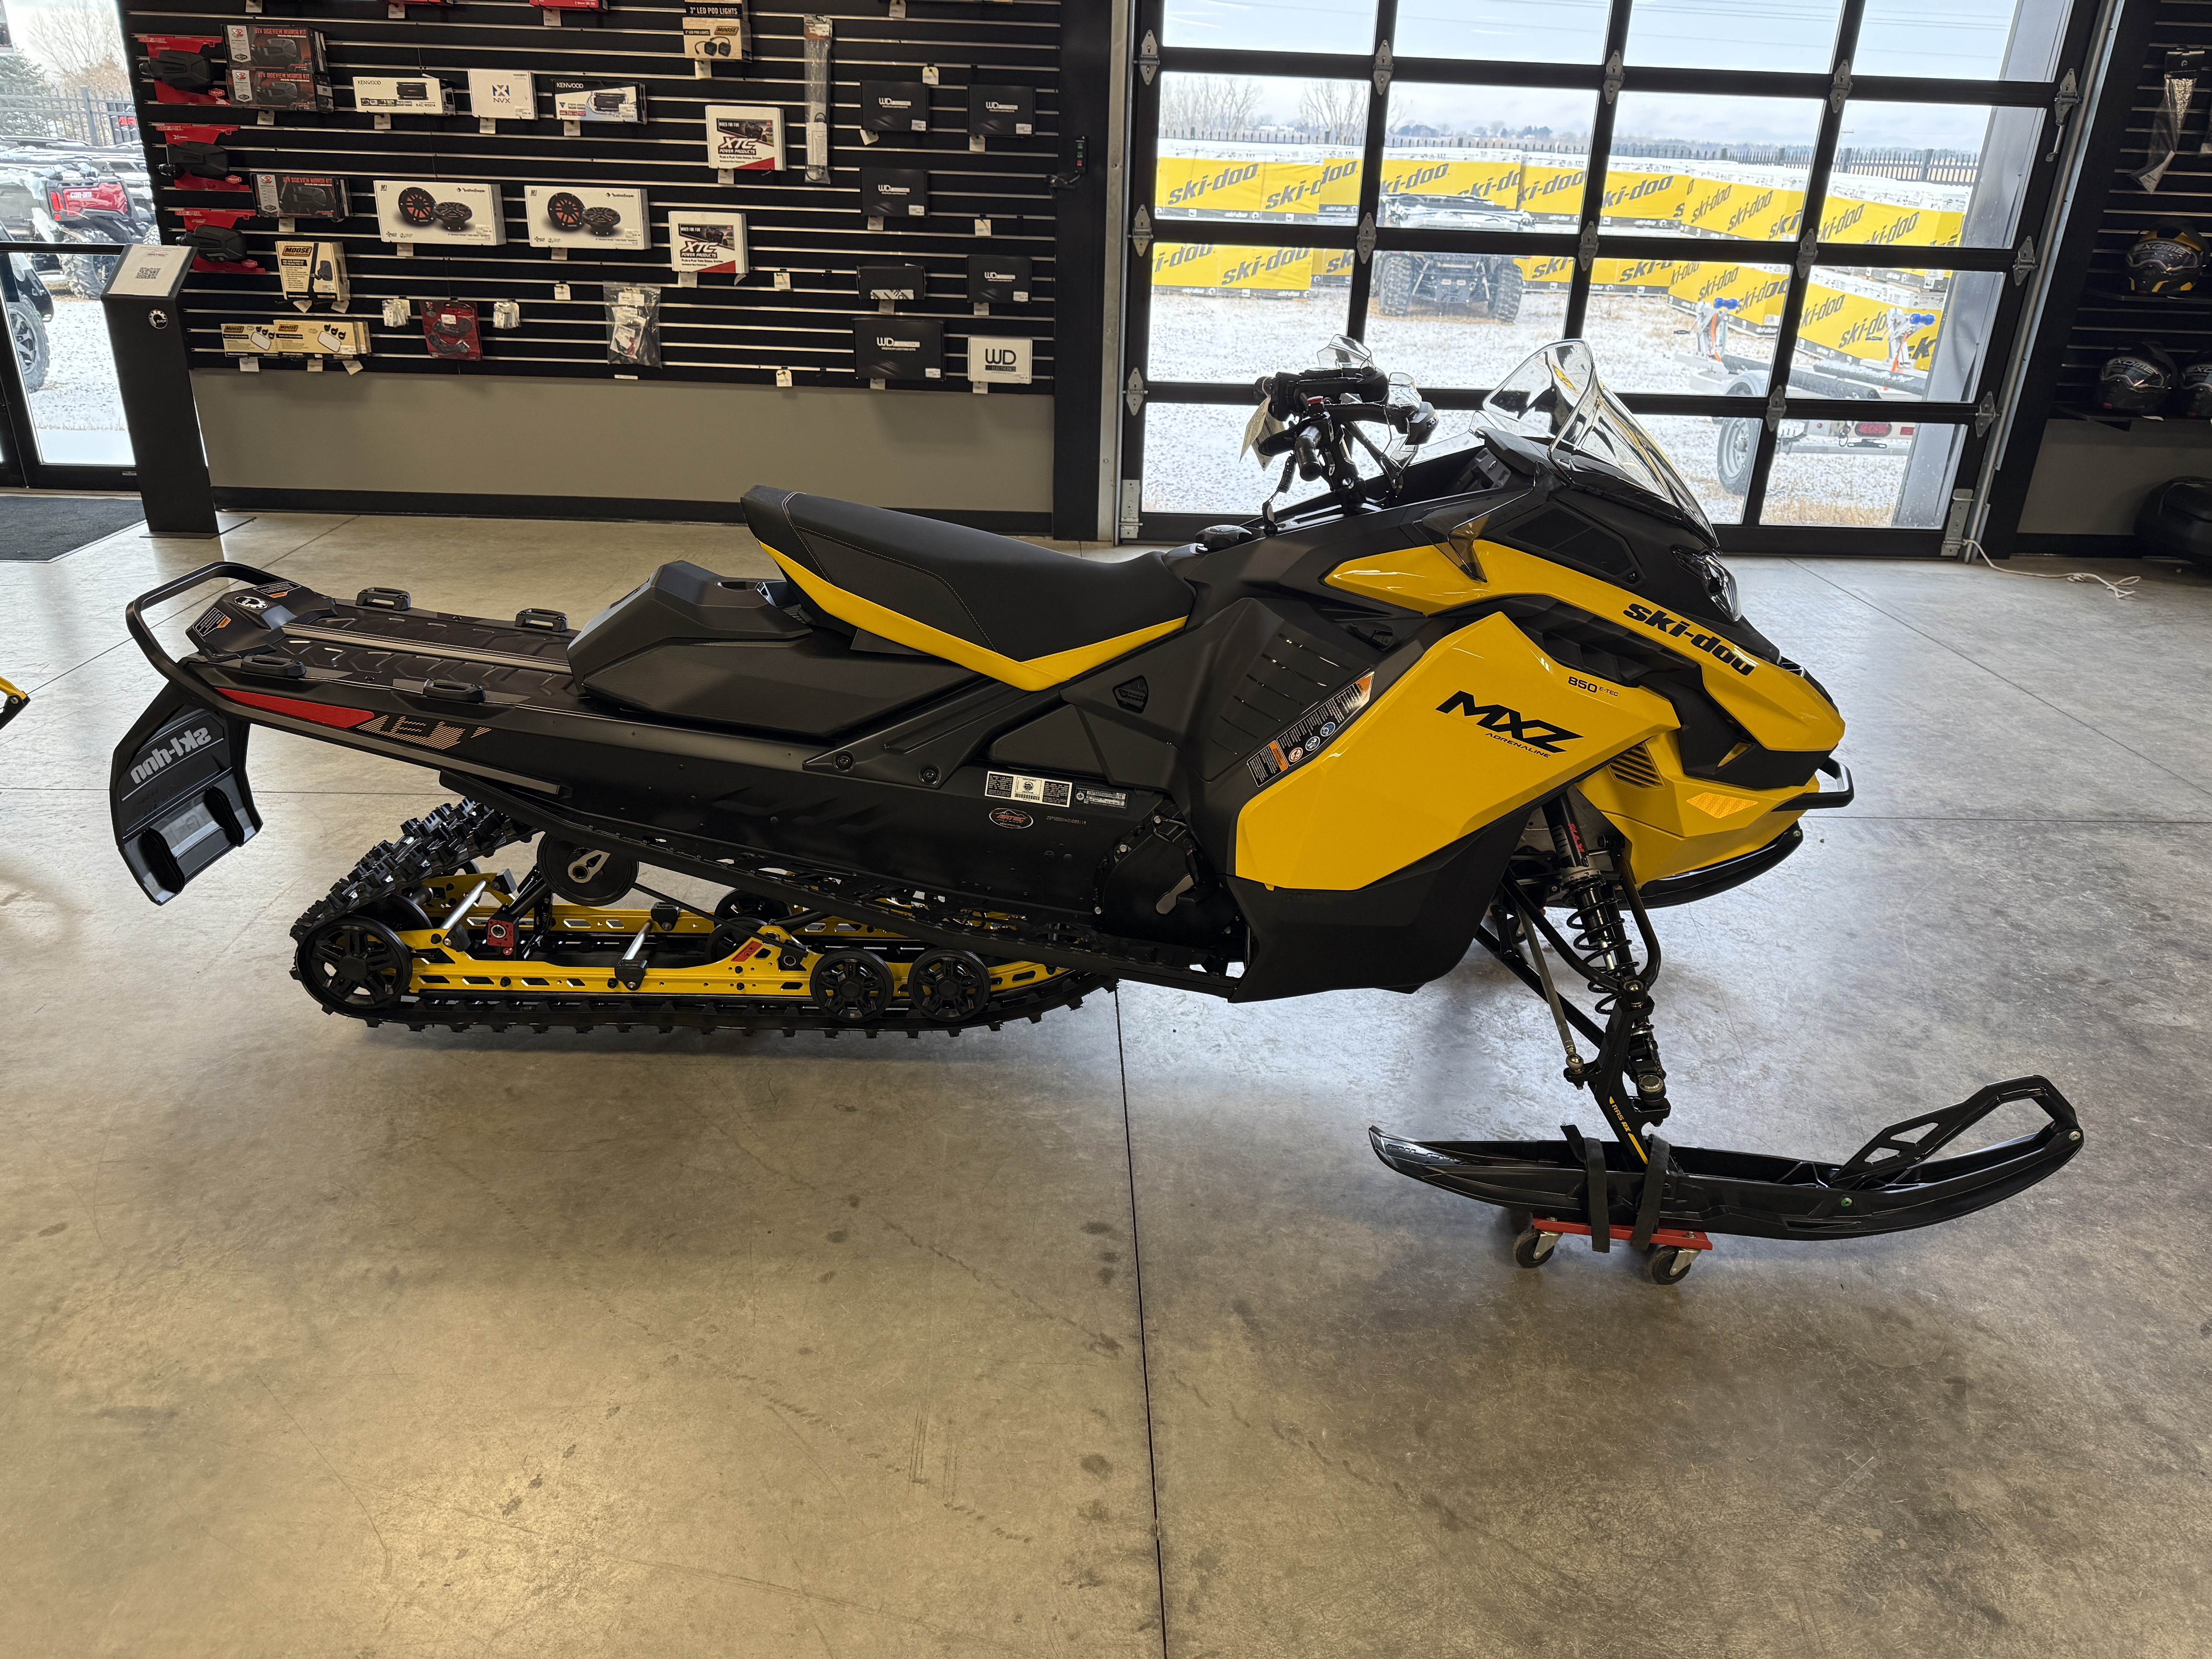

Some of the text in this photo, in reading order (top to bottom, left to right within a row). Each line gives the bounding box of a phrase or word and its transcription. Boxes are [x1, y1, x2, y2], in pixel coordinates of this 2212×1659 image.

[721, 137, 757, 149] XTC
[1168, 163, 1259, 205] ski-doo
[1603, 176, 1673, 208] ki-doo
[1691, 185, 1732, 223] ski-doo
[1728, 190, 1774, 232] ski-doo
[1819, 204, 1865, 241] ki-doo
[682, 242, 718, 252] XTC
[1698, 267, 1739, 301] ski-doo
[877, 337, 895, 347] WD
[1839, 311, 1887, 348] ski-do
[985, 349, 1017, 365] WD
[1623, 603, 1756, 676] ski-doo
[1568, 676, 1619, 697] 850 E-TEC
[1435, 690, 1585, 753] MXZ
[1485, 733, 1551, 758] ADRENALINE
[1612, 1104, 1625, 1121] RAS
